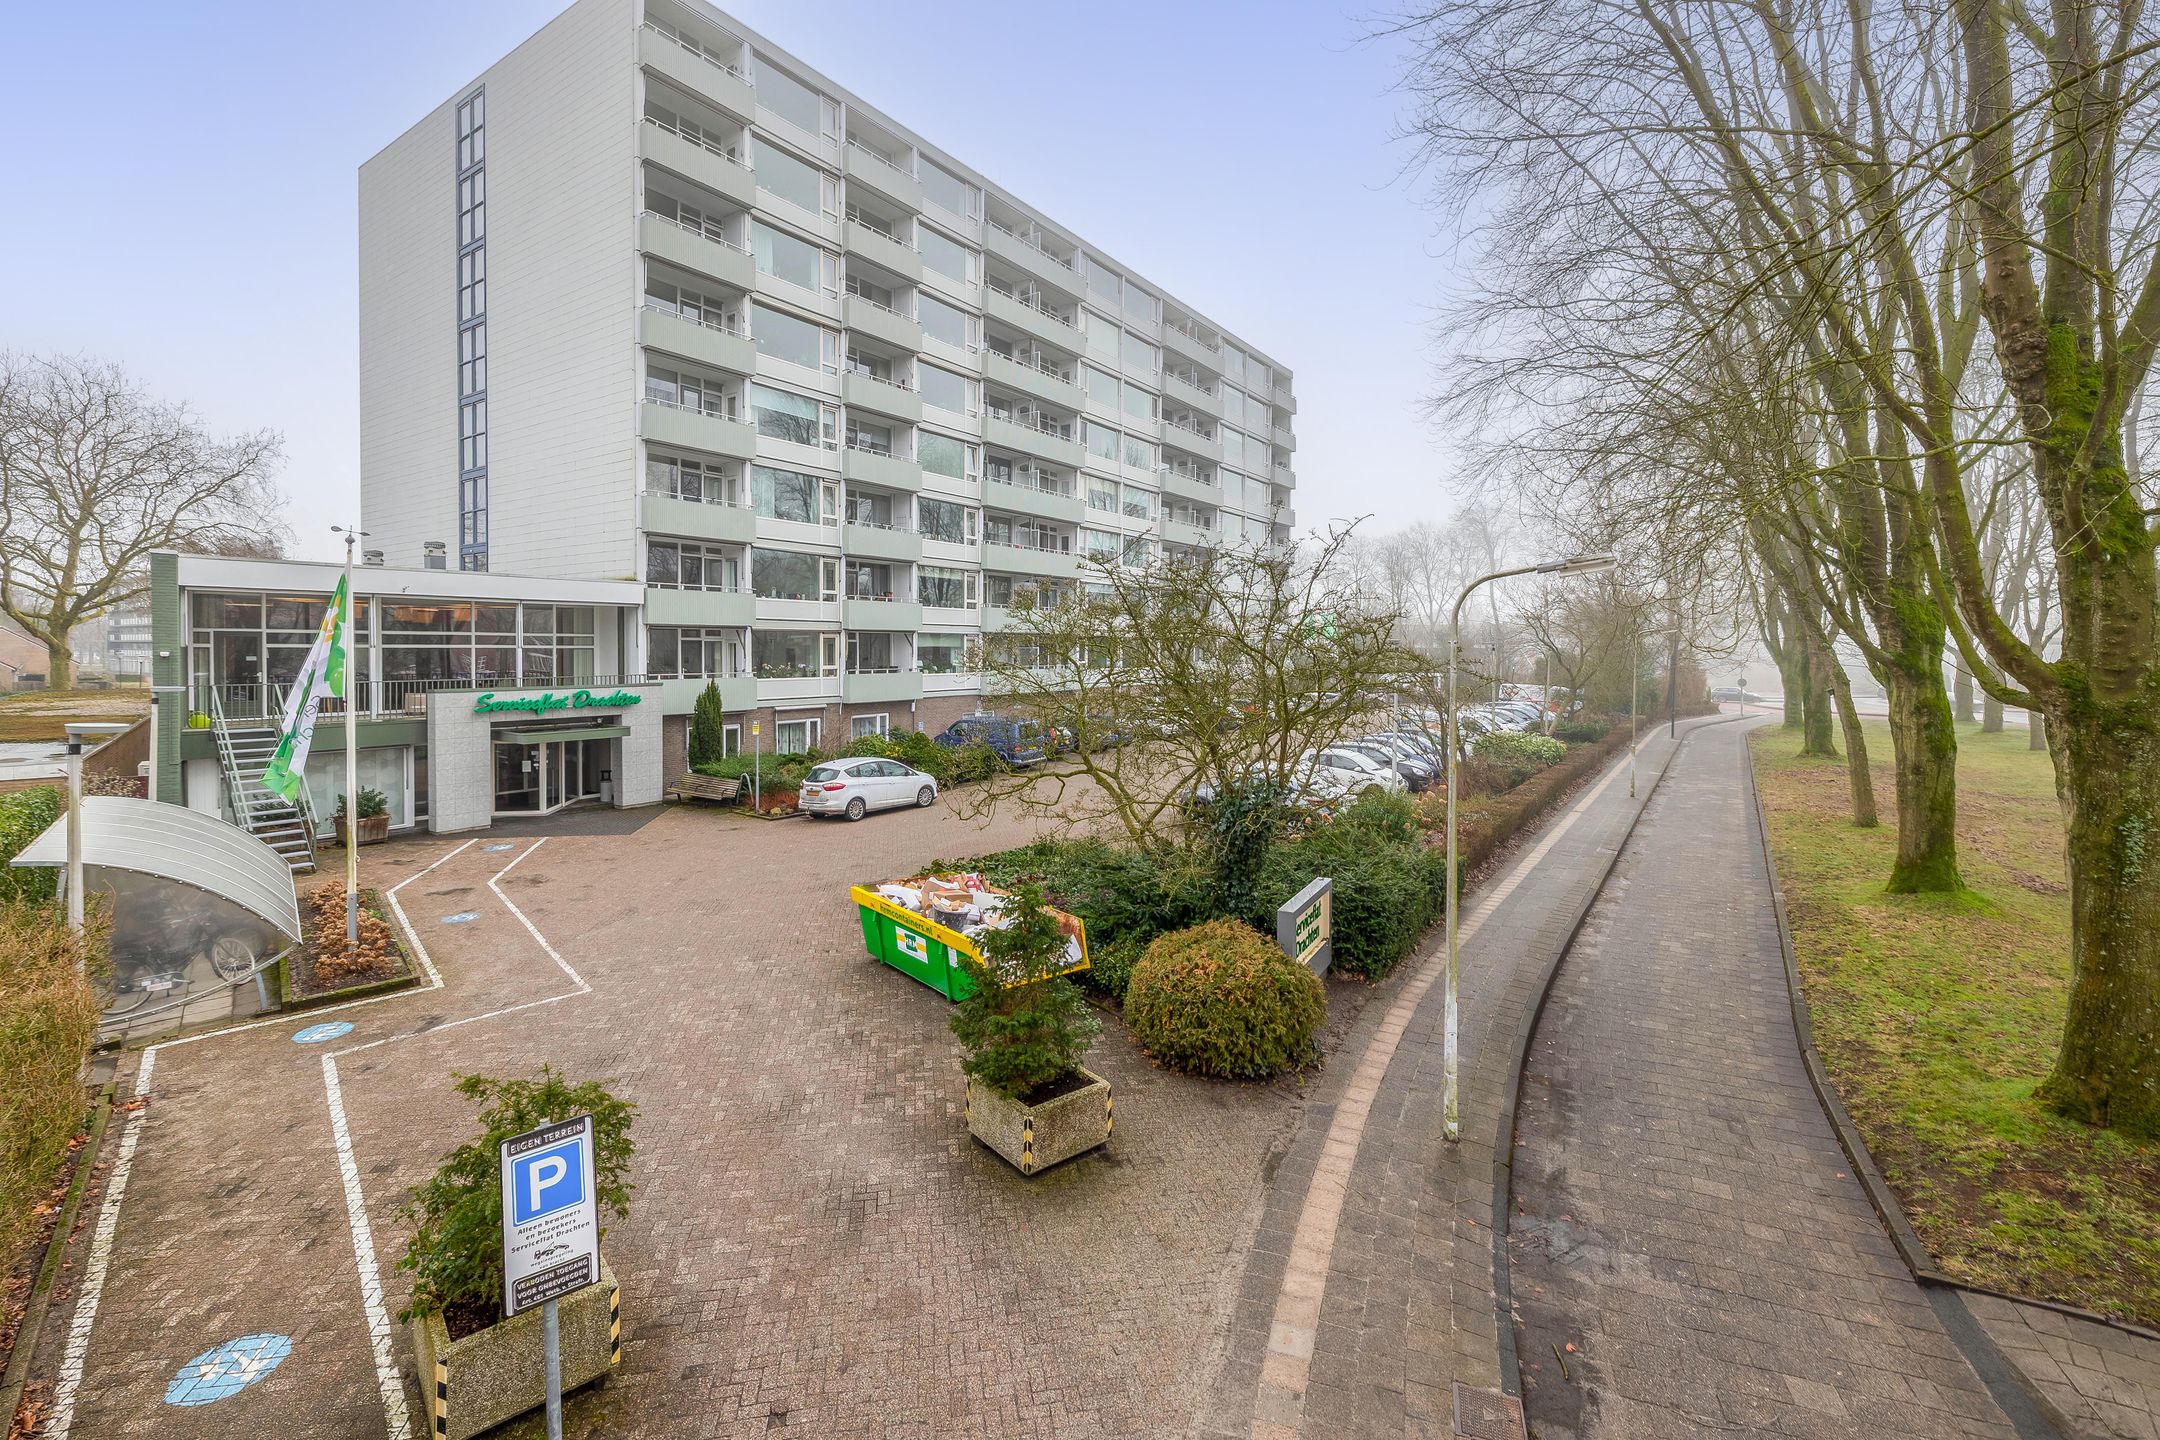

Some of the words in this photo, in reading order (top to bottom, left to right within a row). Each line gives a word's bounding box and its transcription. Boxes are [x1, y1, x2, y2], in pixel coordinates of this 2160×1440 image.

[474, 692, 569, 716] Serviceflat
[572, 689, 642, 708] Drachten
[510, 1136, 543, 1154] EIGEN
[543, 1122, 585, 1143] TERREIN
[529, 1155, 567, 1212] P
[517, 1222, 543, 1236] Alleen
[544, 1209, 582, 1226] bewoners
[525, 1233, 536, 1241] en
[537, 1219, 577, 1237] bezoekers
[511, 1233, 554, 1254] Serviceflat
[556, 1221, 590, 1238] Drachten
[556, 1258, 589, 1276] TOEGANG
[516, 1286, 538, 1300] VOOR
[538, 1267, 589, 1292] ONBEVOEGDEN
